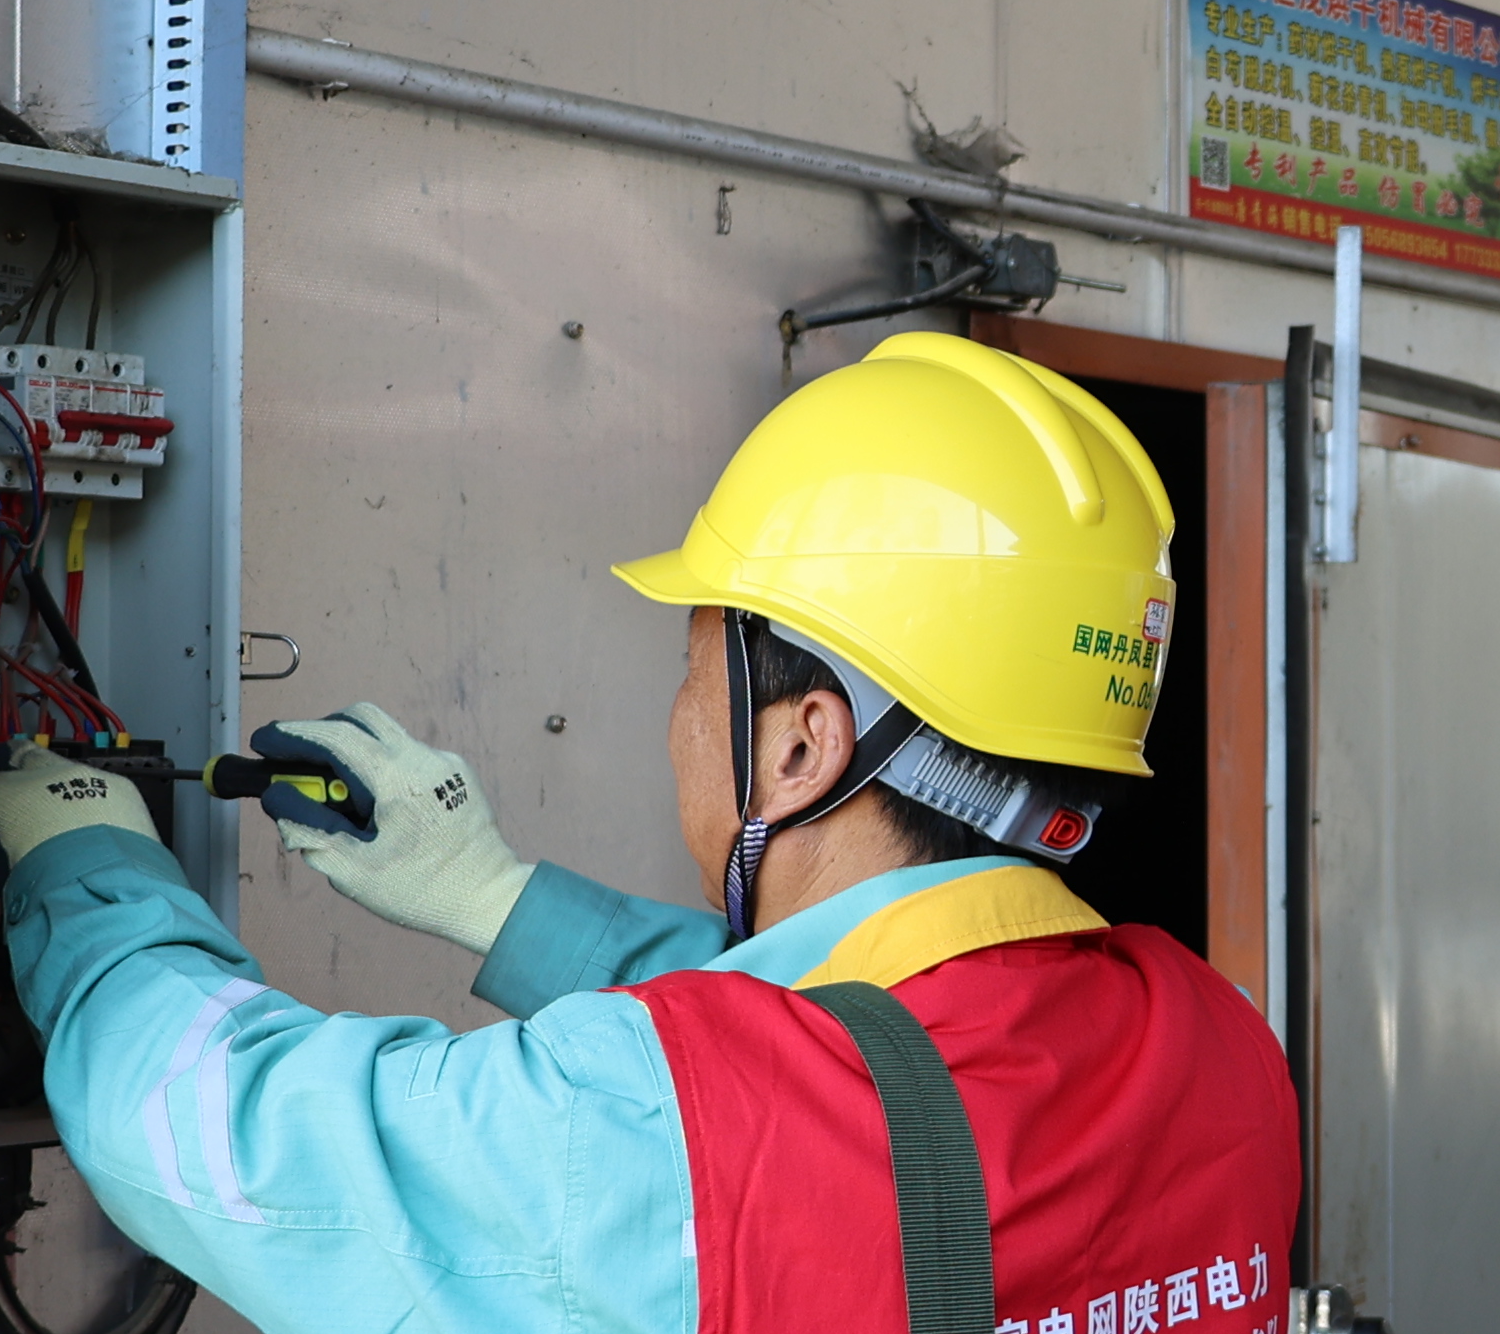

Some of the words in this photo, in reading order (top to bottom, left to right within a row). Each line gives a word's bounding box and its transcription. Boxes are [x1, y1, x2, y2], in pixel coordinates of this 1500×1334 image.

[1244, 142, 1360, 199] 专利产品
[46, 777, 108, 795] 耐电压
[63, 788, 107, 801] 400V
